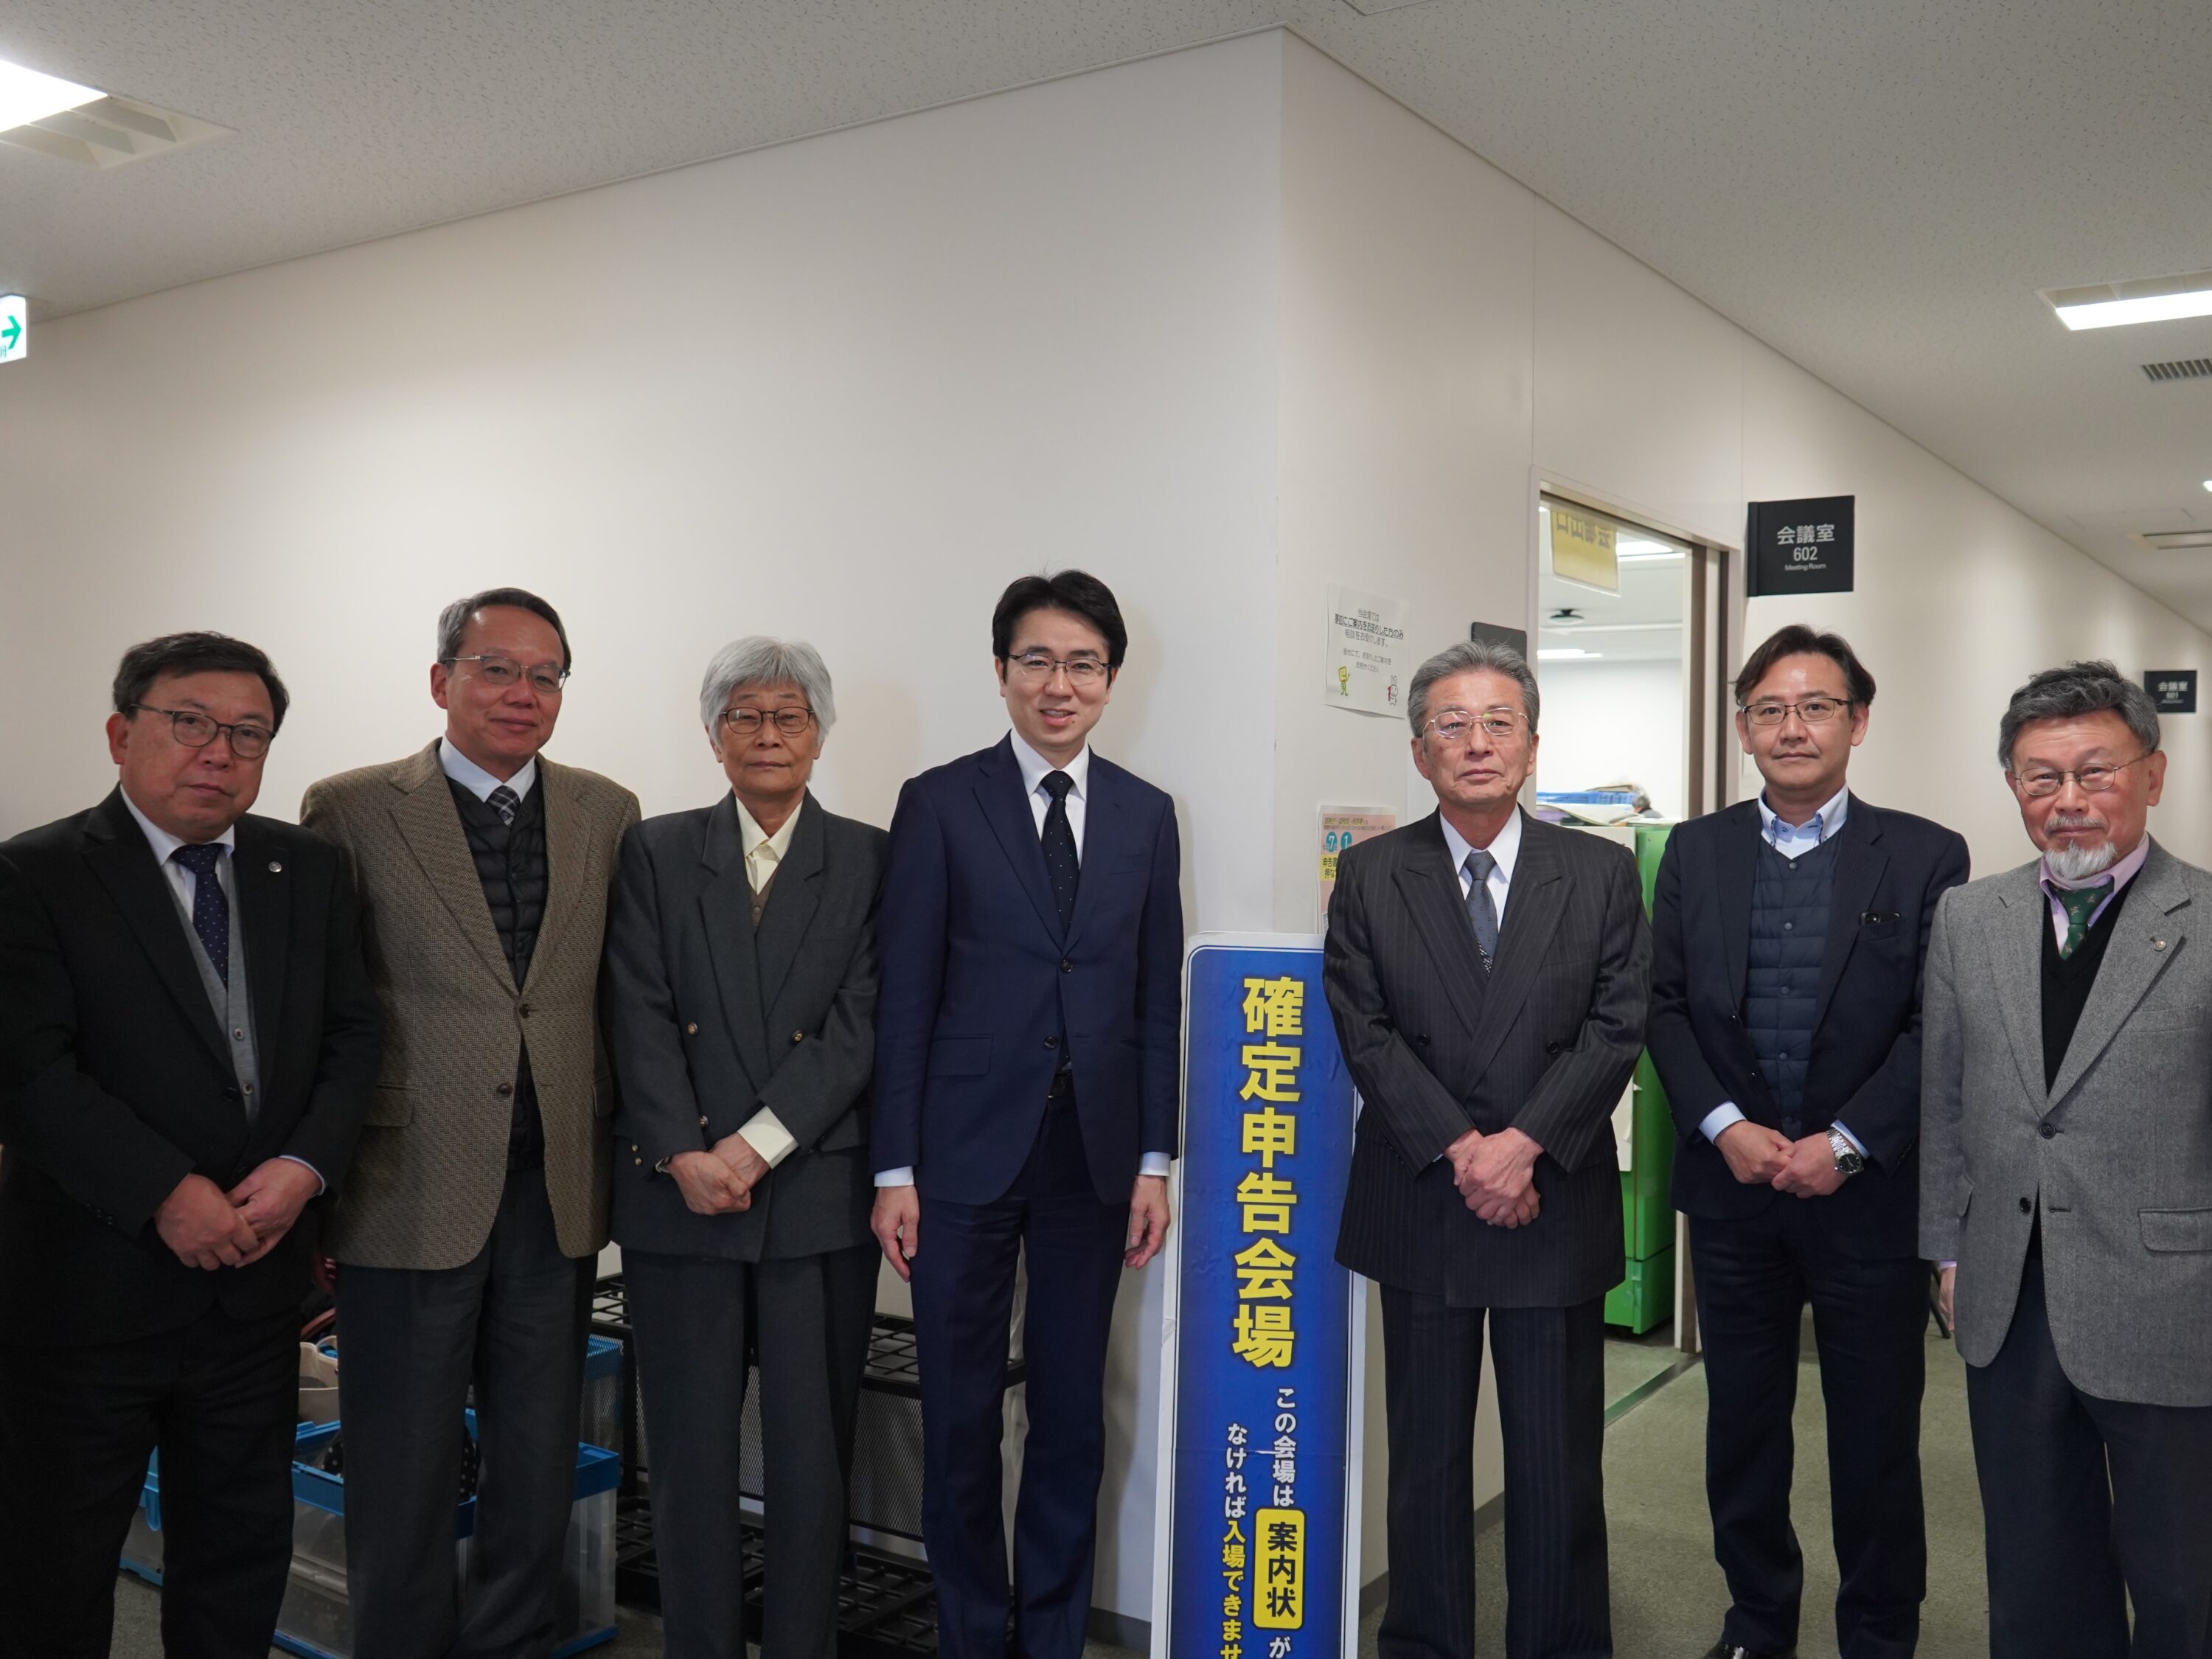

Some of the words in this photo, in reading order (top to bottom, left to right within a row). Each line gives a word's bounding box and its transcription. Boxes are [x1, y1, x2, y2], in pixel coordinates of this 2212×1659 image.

[1777, 524, 1835, 545] 会議室
[1793, 546, 1818, 561] 602
[1232, 977, 1304, 1368] 確定申告会場
